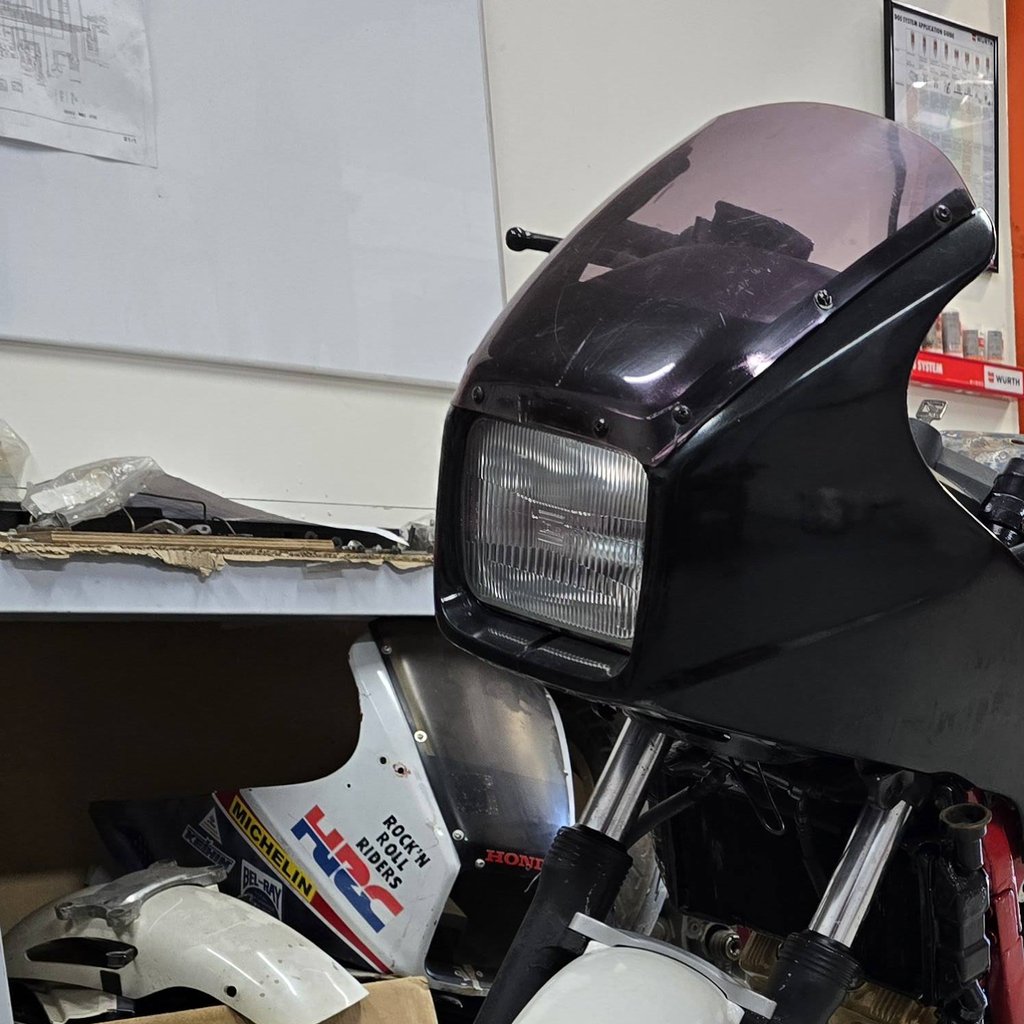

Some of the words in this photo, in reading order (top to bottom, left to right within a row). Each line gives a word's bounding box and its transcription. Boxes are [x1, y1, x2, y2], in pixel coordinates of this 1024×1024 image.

[918, 20, 943, 35] APPLICATION
[232, 801, 312, 897] MICHELIN
[355, 836, 402, 890] RIDERS
[376, 831, 409, 872] ROLL
[383, 814, 431, 869] ROCK'N
[485, 848, 545, 871] HOND
[242, 865, 282, 904] BEL-RAY
[290, 804, 404, 934] HRC
